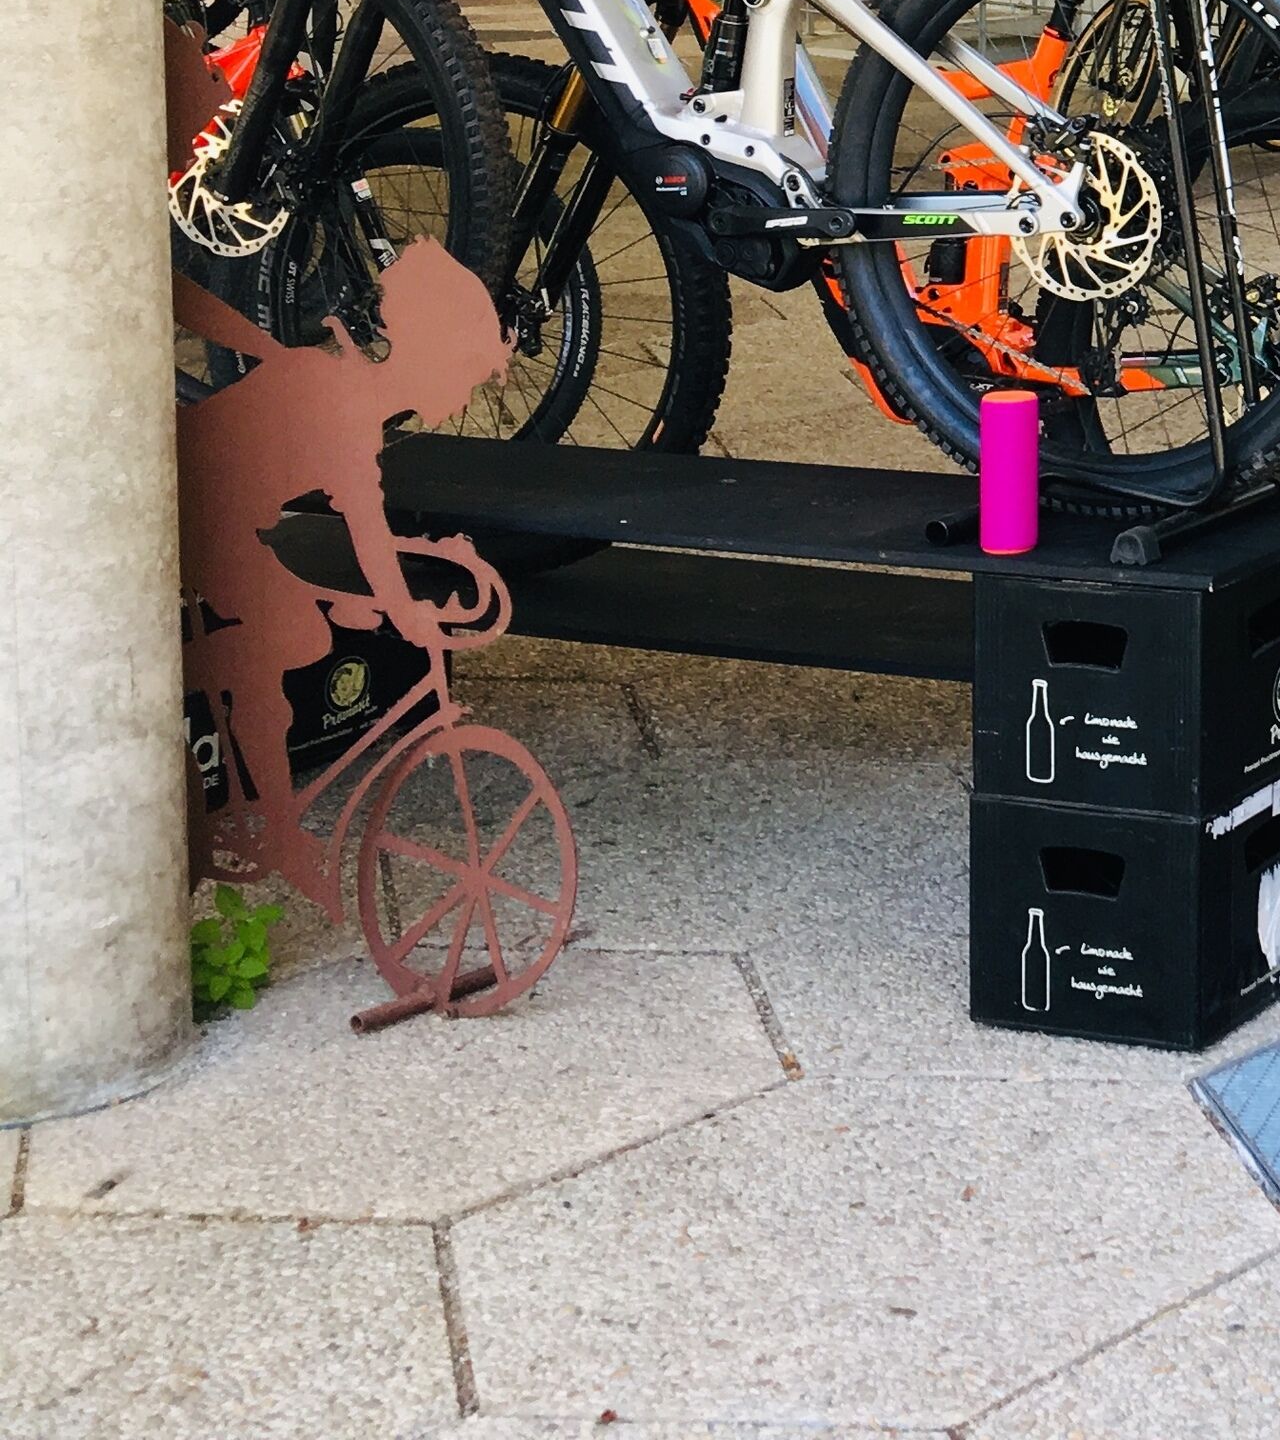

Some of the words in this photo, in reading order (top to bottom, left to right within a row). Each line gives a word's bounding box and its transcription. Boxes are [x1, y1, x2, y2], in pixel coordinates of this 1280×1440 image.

[902, 214, 959, 225] SCOTT
[1084, 712, 1138, 729] Limonade
[1080, 942, 1134, 960] Limonade
